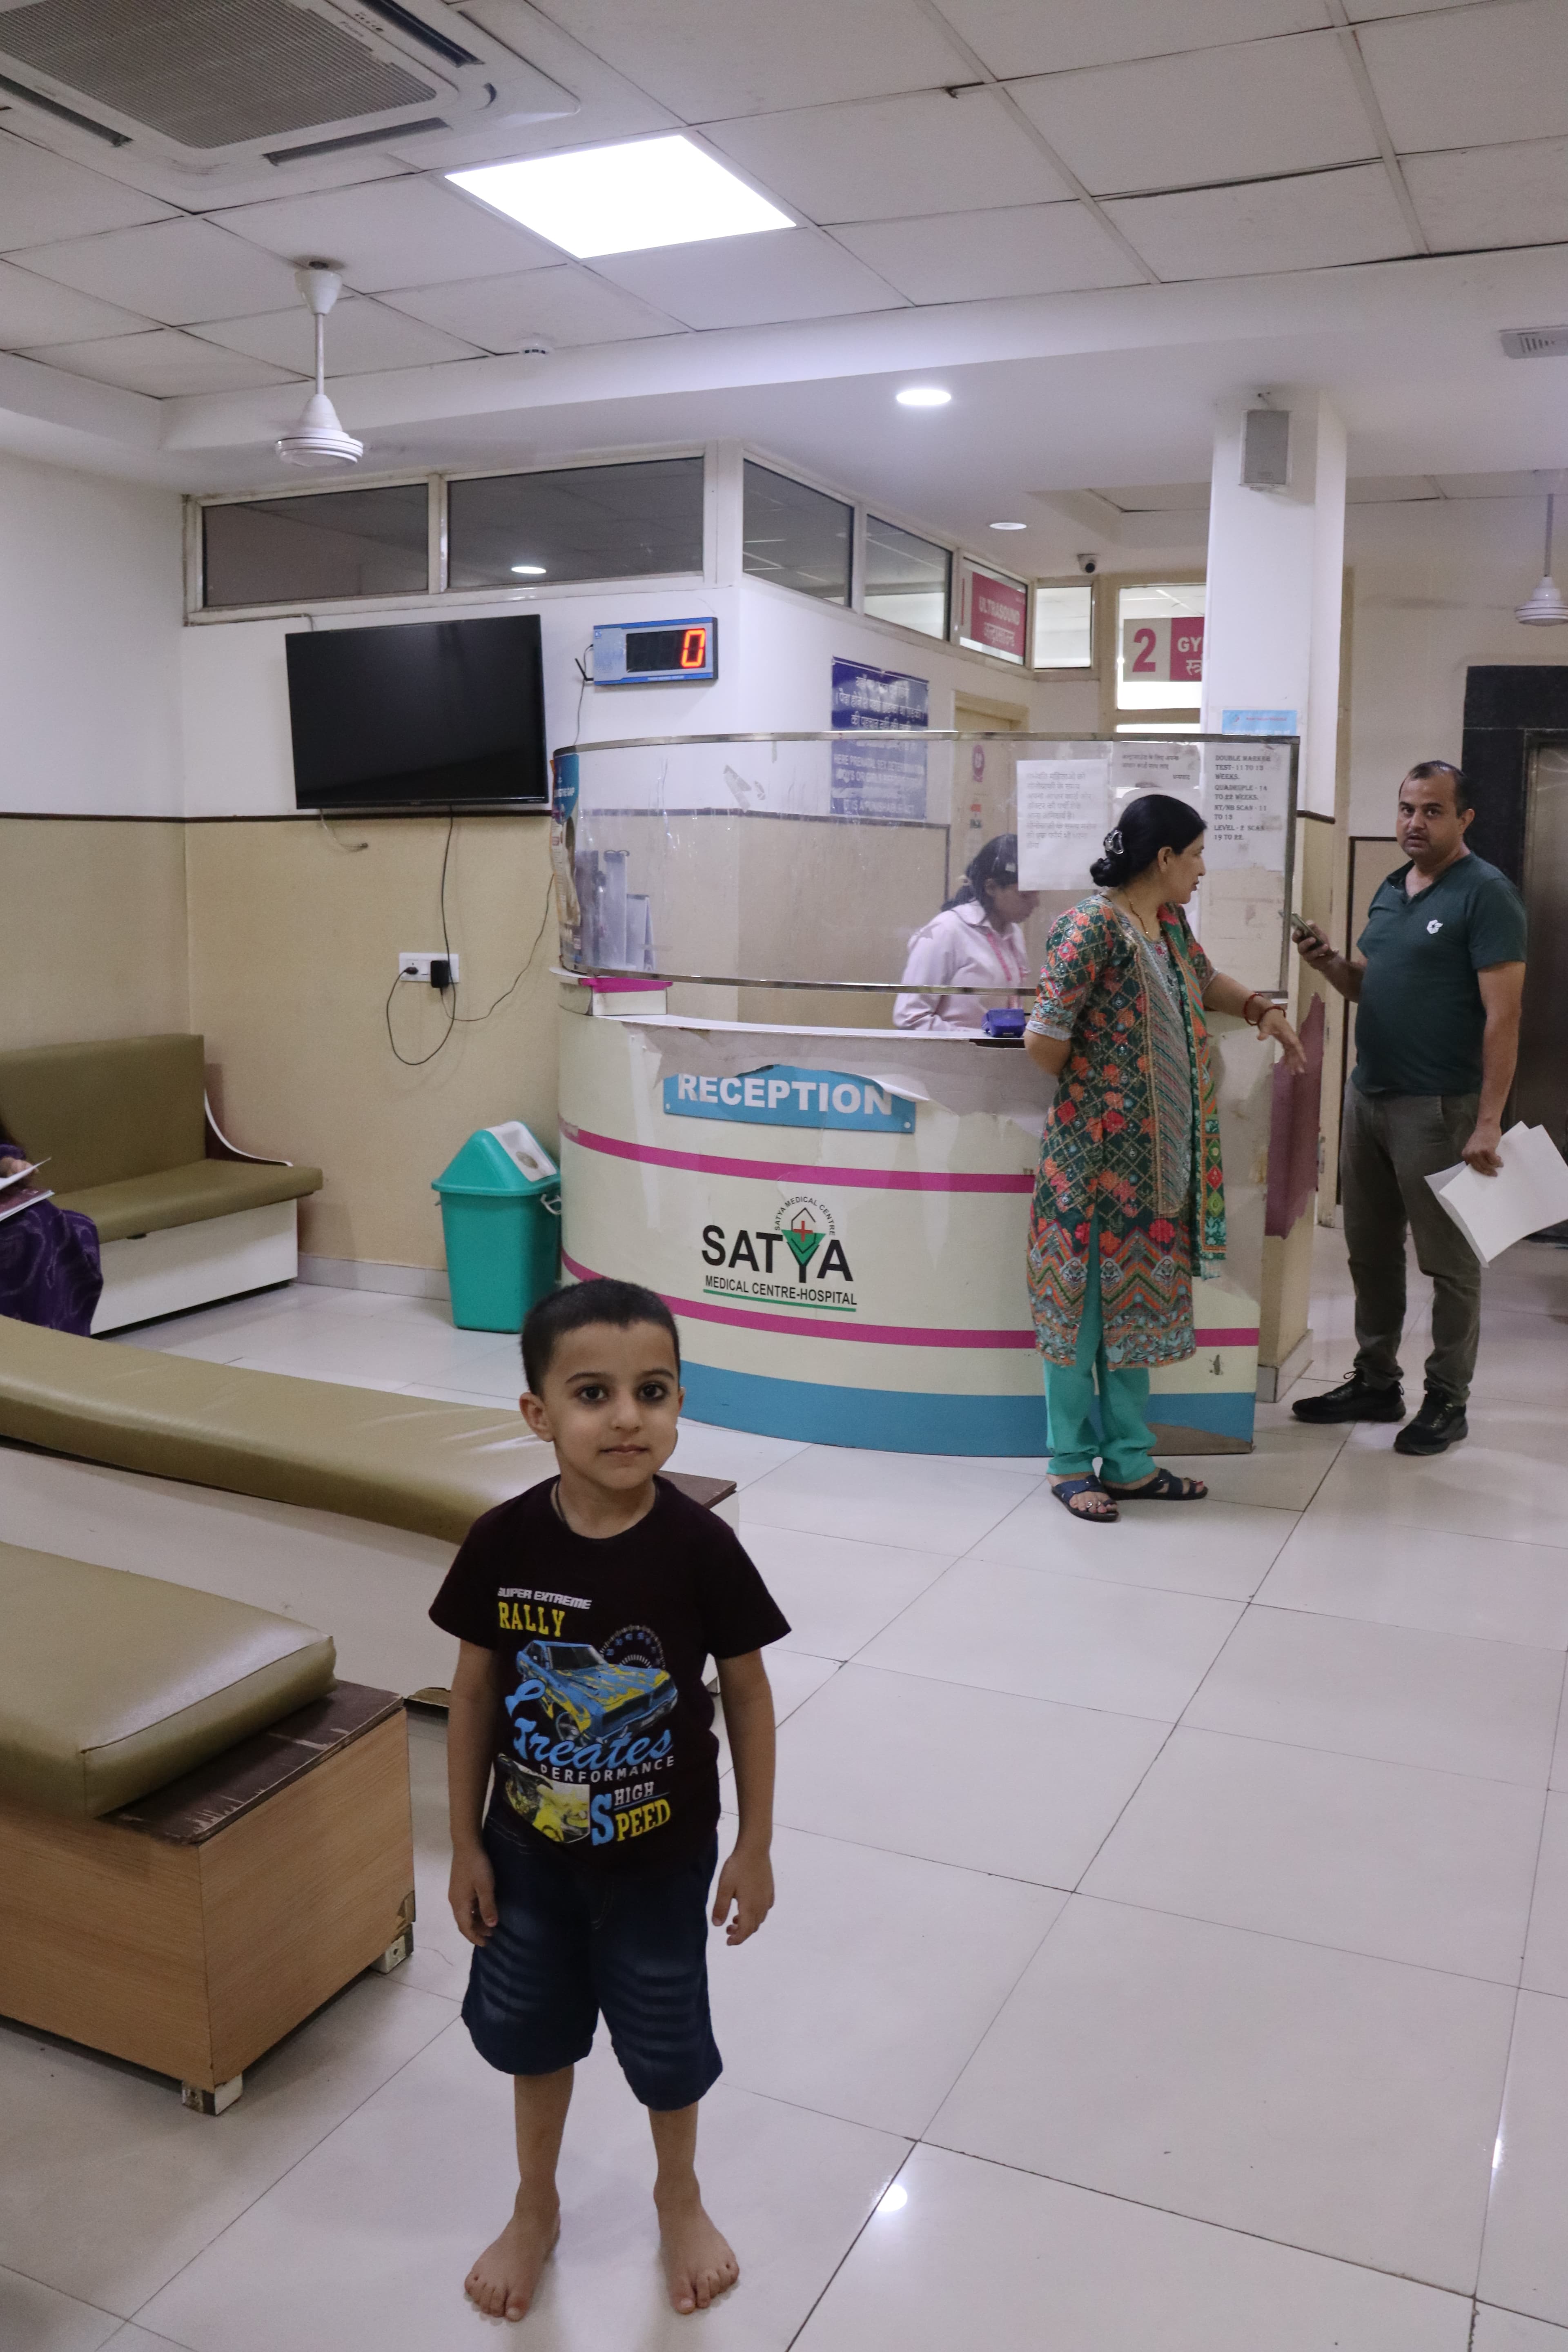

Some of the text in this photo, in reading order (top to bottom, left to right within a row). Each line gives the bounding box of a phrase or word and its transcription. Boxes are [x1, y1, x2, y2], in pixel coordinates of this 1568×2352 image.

[979, 596, 1020, 626] ULTRASOUND
[681, 628, 706, 668] 0
[1132, 628, 1156, 673] 2
[1178, 637, 1203, 653] GY
[678, 1074, 892, 1115] RECEPTION
[775, 1196, 835, 1236] SATYA MEDICAL CENTRE
[702, 1225, 854, 1283] SATYA
[706, 1275, 858, 1305] MEDICAL CENTRE-HOSPITAL
[497, 1587, 592, 1610] SUPER EXTREME
[498, 1601, 565, 1637] RALLY
[615, 1782, 654, 1806] HIGH
